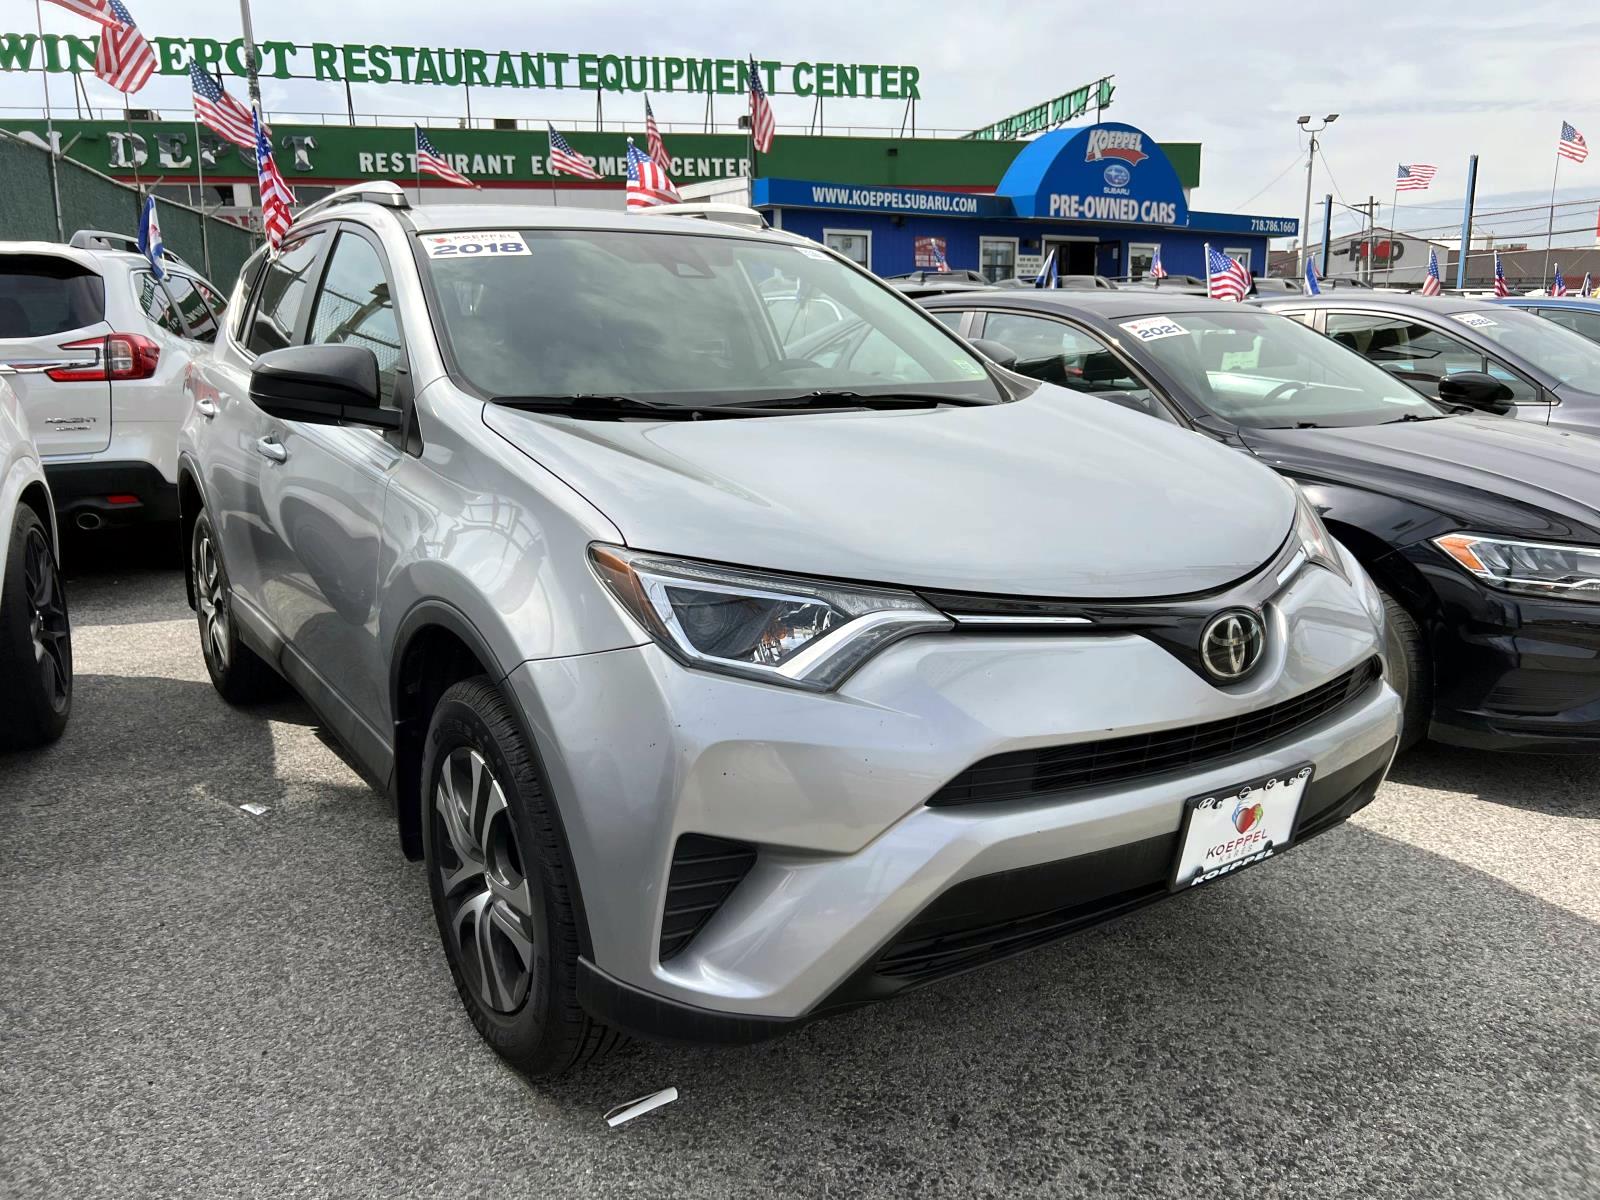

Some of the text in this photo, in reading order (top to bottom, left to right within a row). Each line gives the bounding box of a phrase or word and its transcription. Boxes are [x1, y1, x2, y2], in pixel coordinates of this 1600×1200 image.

[154, 37, 297, 79] EPOT
[312, 42, 569, 89] RESTAURANT
[578, 53, 781, 96] EQUIPMENT
[792, 61, 921, 100] CENTER
[1086, 129, 1143, 161] KOEPPEL
[670, 156, 752, 177] CENTER
[812, 186, 977, 213] WWW.KOEPPELSUBARU.COM
[1103, 187, 1130, 196] SUBARU
[1049, 194, 1177, 224] PRE-OWNED CARS
[1251, 219, 1296, 233] 718.786.1660
[433, 242, 524, 256] 2018
[1137, 324, 1183, 339] 2021
[1205, 828, 1268, 860] KOEPPEL
[1190, 848, 1275, 886] KOEPPEL
